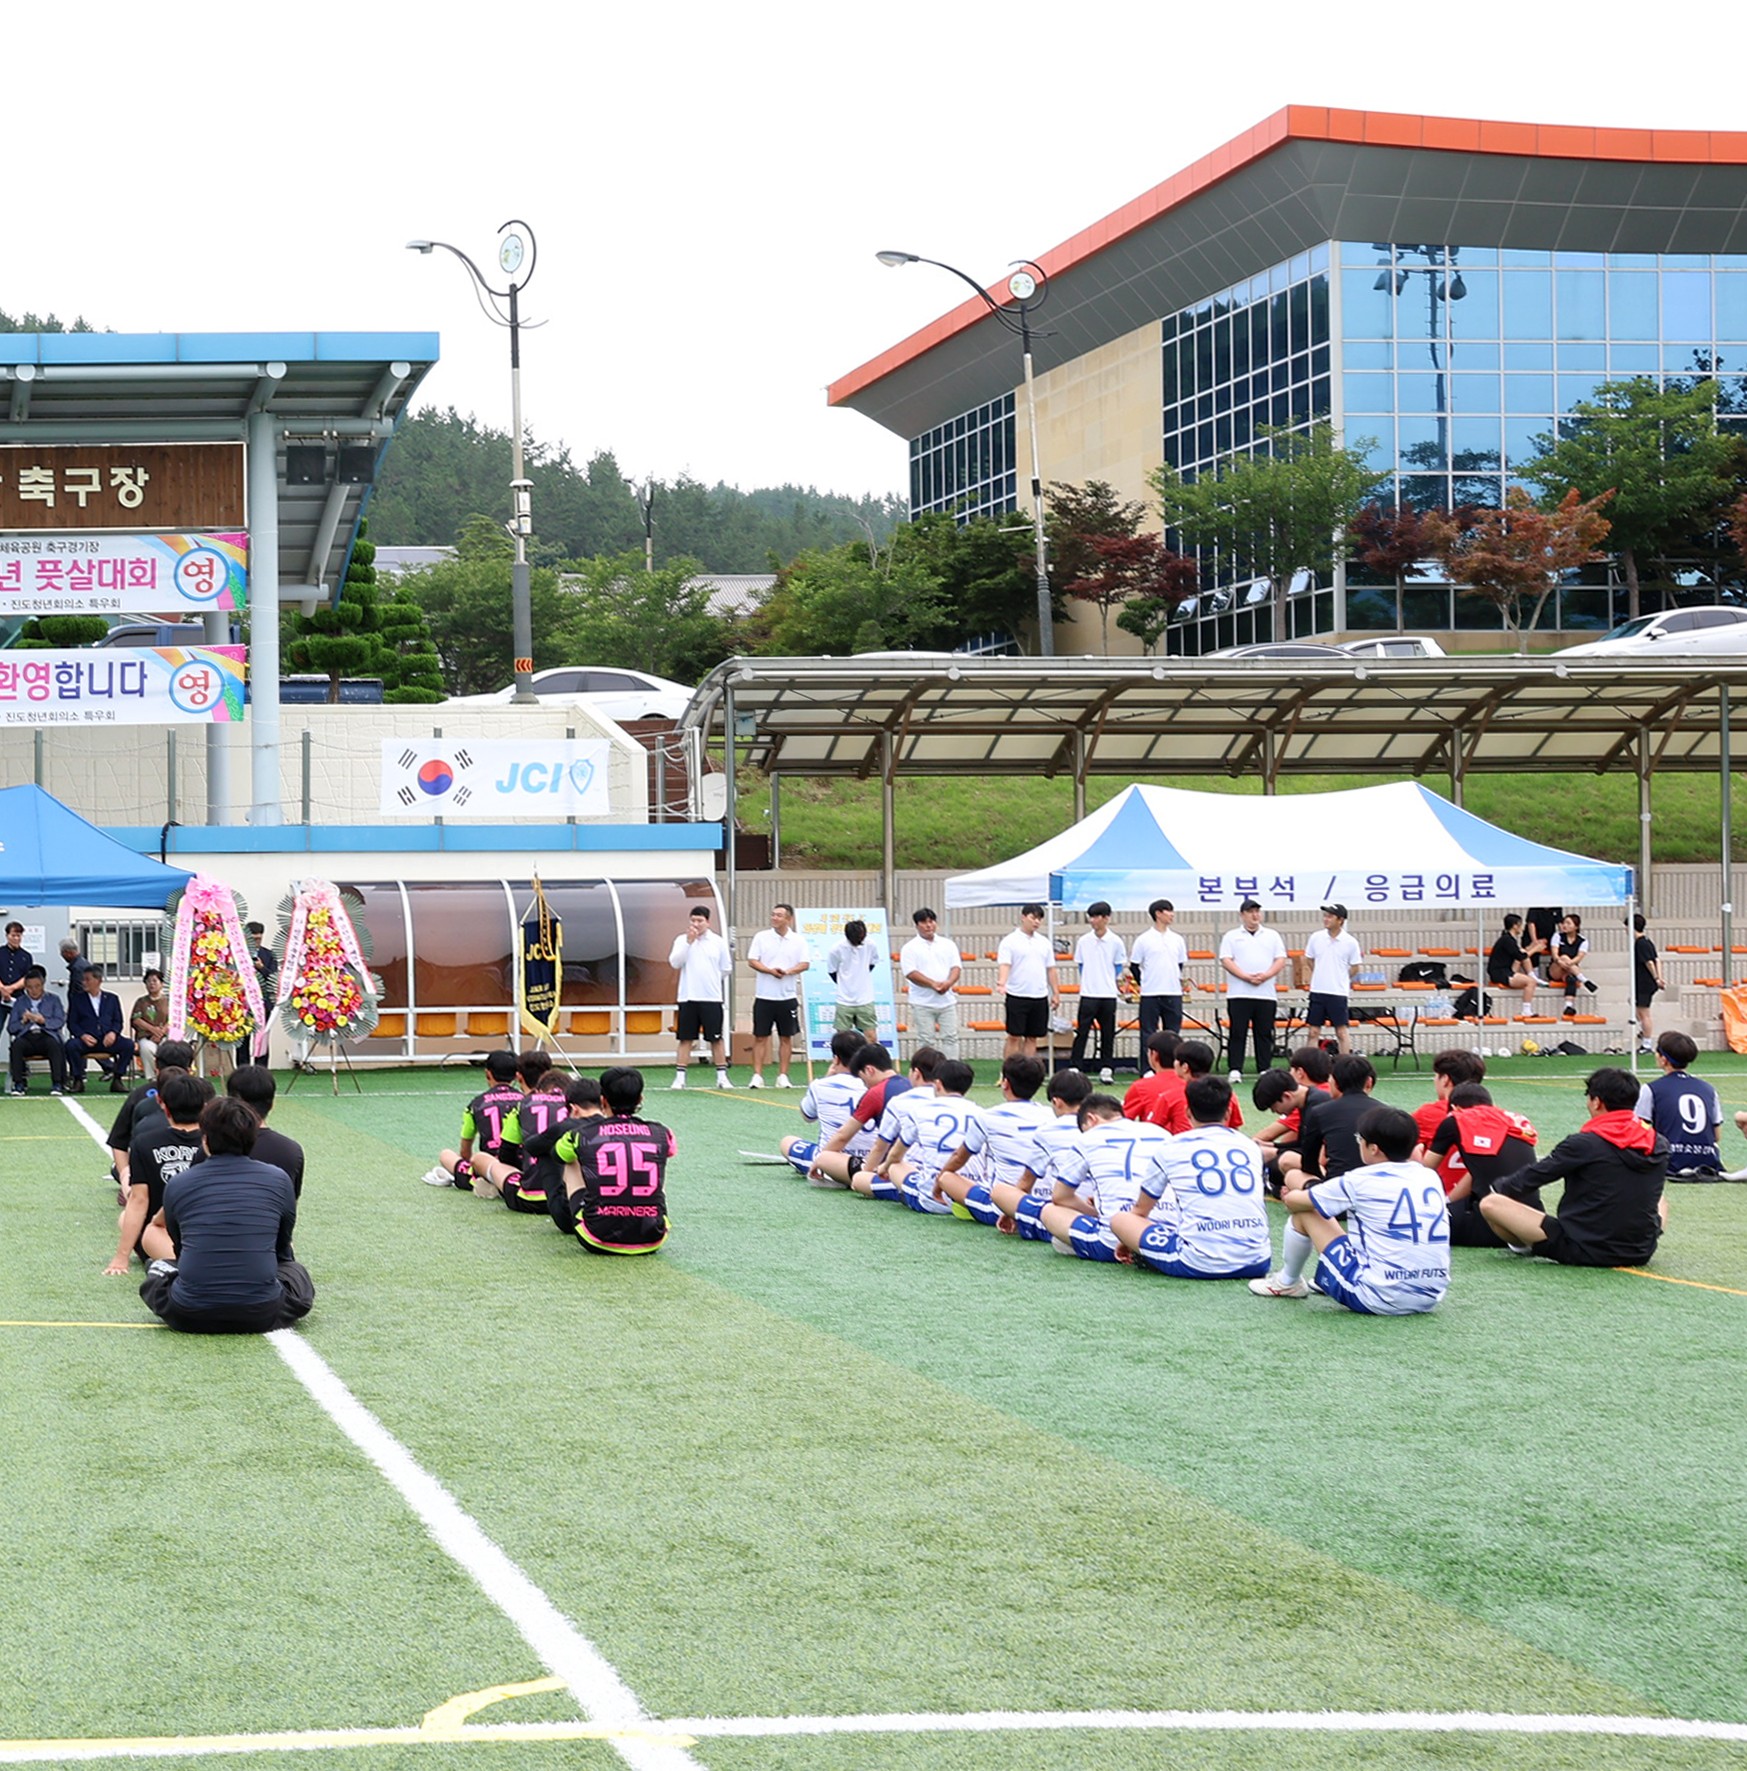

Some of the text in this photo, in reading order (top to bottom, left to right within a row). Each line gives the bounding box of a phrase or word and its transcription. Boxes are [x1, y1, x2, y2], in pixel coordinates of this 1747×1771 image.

[18, 466, 149, 508] 축구장
[46, 541, 100, 553] 축구경기장
[35, 557, 157, 592] 풋살대회
[183, 557, 214, 593] 영
[178, 670, 210, 705] 영
[496, 762, 563, 794] JCI
[1197, 875, 1295, 902] 본부석
[1364, 874, 1496, 902] 응급의료
[599, 1123, 651, 1136] HOSEUNG
[1679, 1094, 1706, 1134] 9
[596, 1142, 659, 1196] 95
[1191, 1149, 1255, 1196] 88
[597, 1205, 658, 1217] MARINERS
[1388, 1187, 1448, 1245] 42
